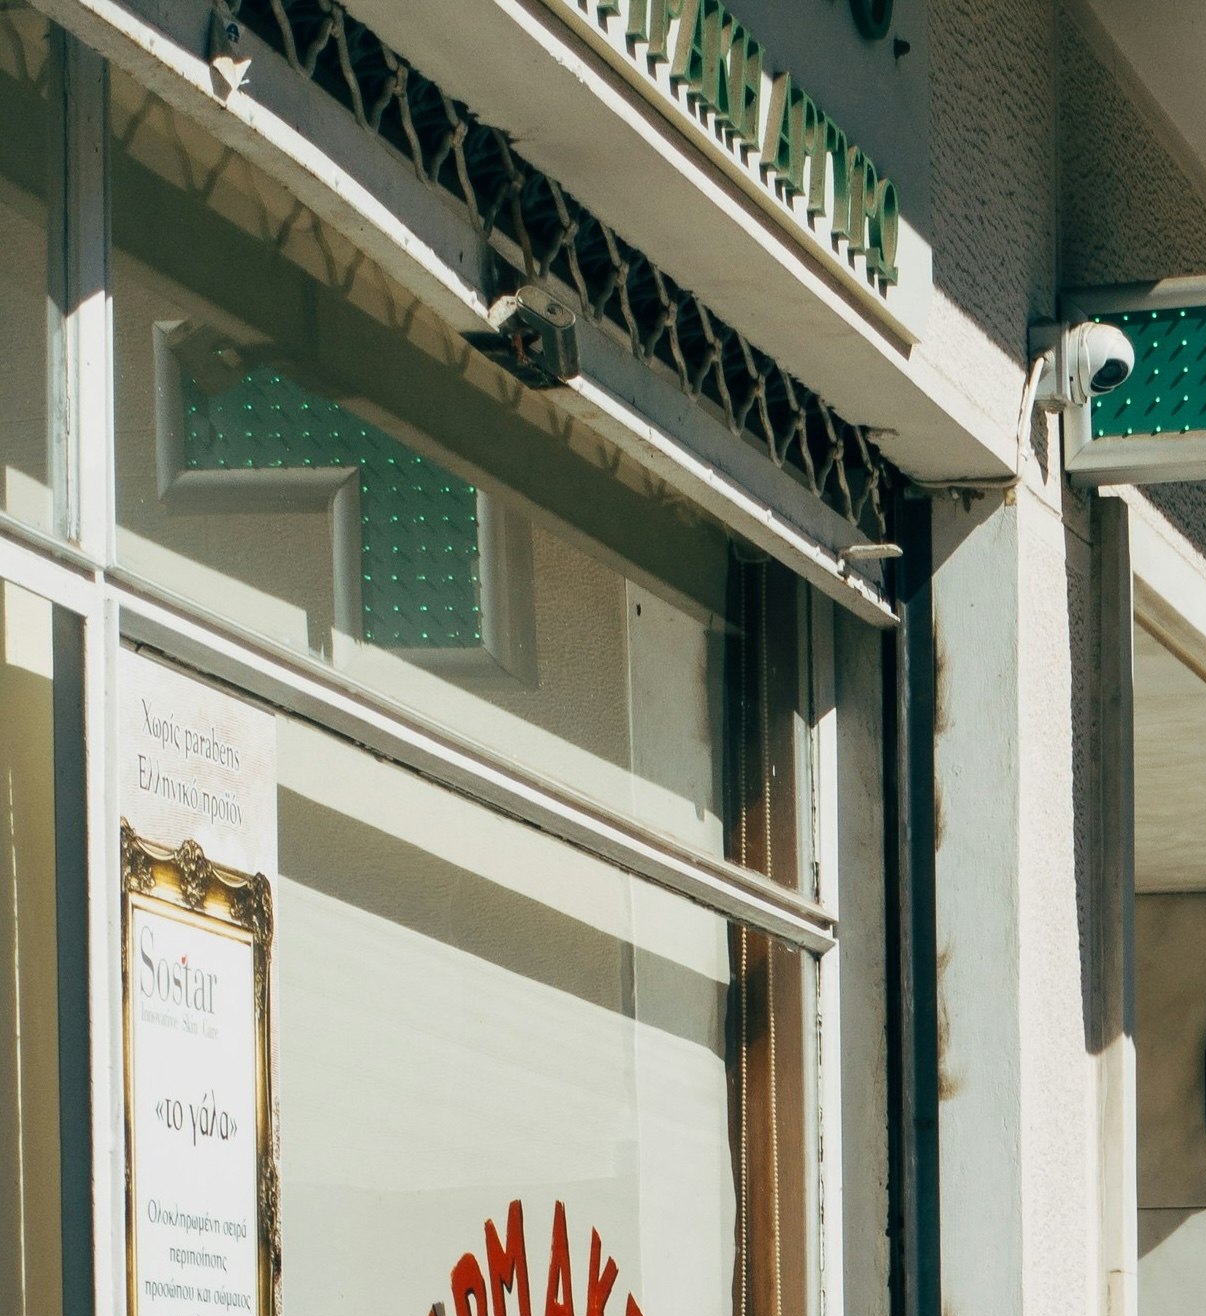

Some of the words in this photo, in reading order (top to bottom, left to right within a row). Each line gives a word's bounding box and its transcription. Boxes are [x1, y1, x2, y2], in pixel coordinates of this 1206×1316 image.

[141, 698, 180, 750] Χωρίς
[184, 727, 240, 771] parabens
[138, 753, 199, 810] Ελληνικό
[202, 792, 243, 826] προϊόν
[140, 925, 218, 1015] Sostar
[189, 1090, 238, 1147] γάλα»
[148, 1199, 221, 1236] Ολοκληρωμένη
[223, 1218, 247, 1242] σειρά
[196, 1288, 211, 1303] και
